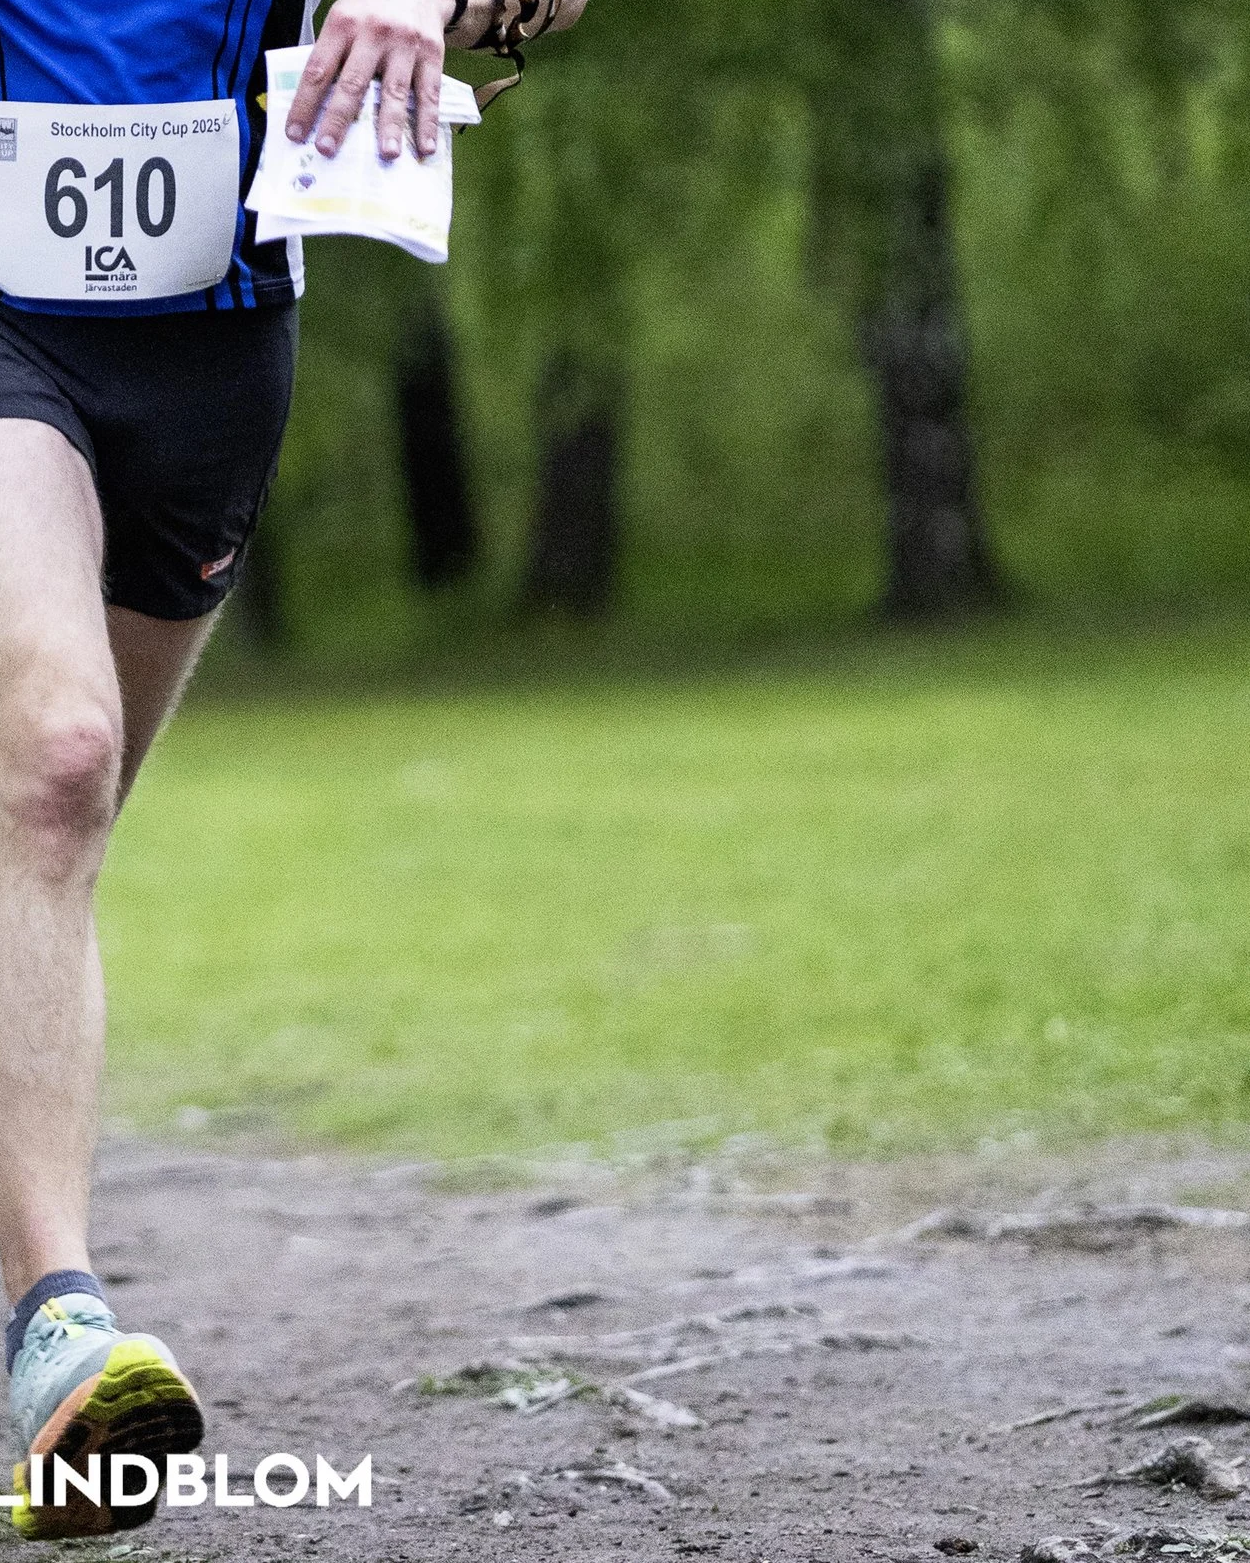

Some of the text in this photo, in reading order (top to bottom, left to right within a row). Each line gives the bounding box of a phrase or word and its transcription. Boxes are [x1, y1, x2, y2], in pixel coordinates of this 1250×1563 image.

[50, 118, 221, 140] Stockholm City Cup 2025
[44, 156, 177, 238] 610
[85, 245, 137, 272] ICA
[110, 271, 138, 281] nära
[84, 283, 138, 293] Järvastaden
